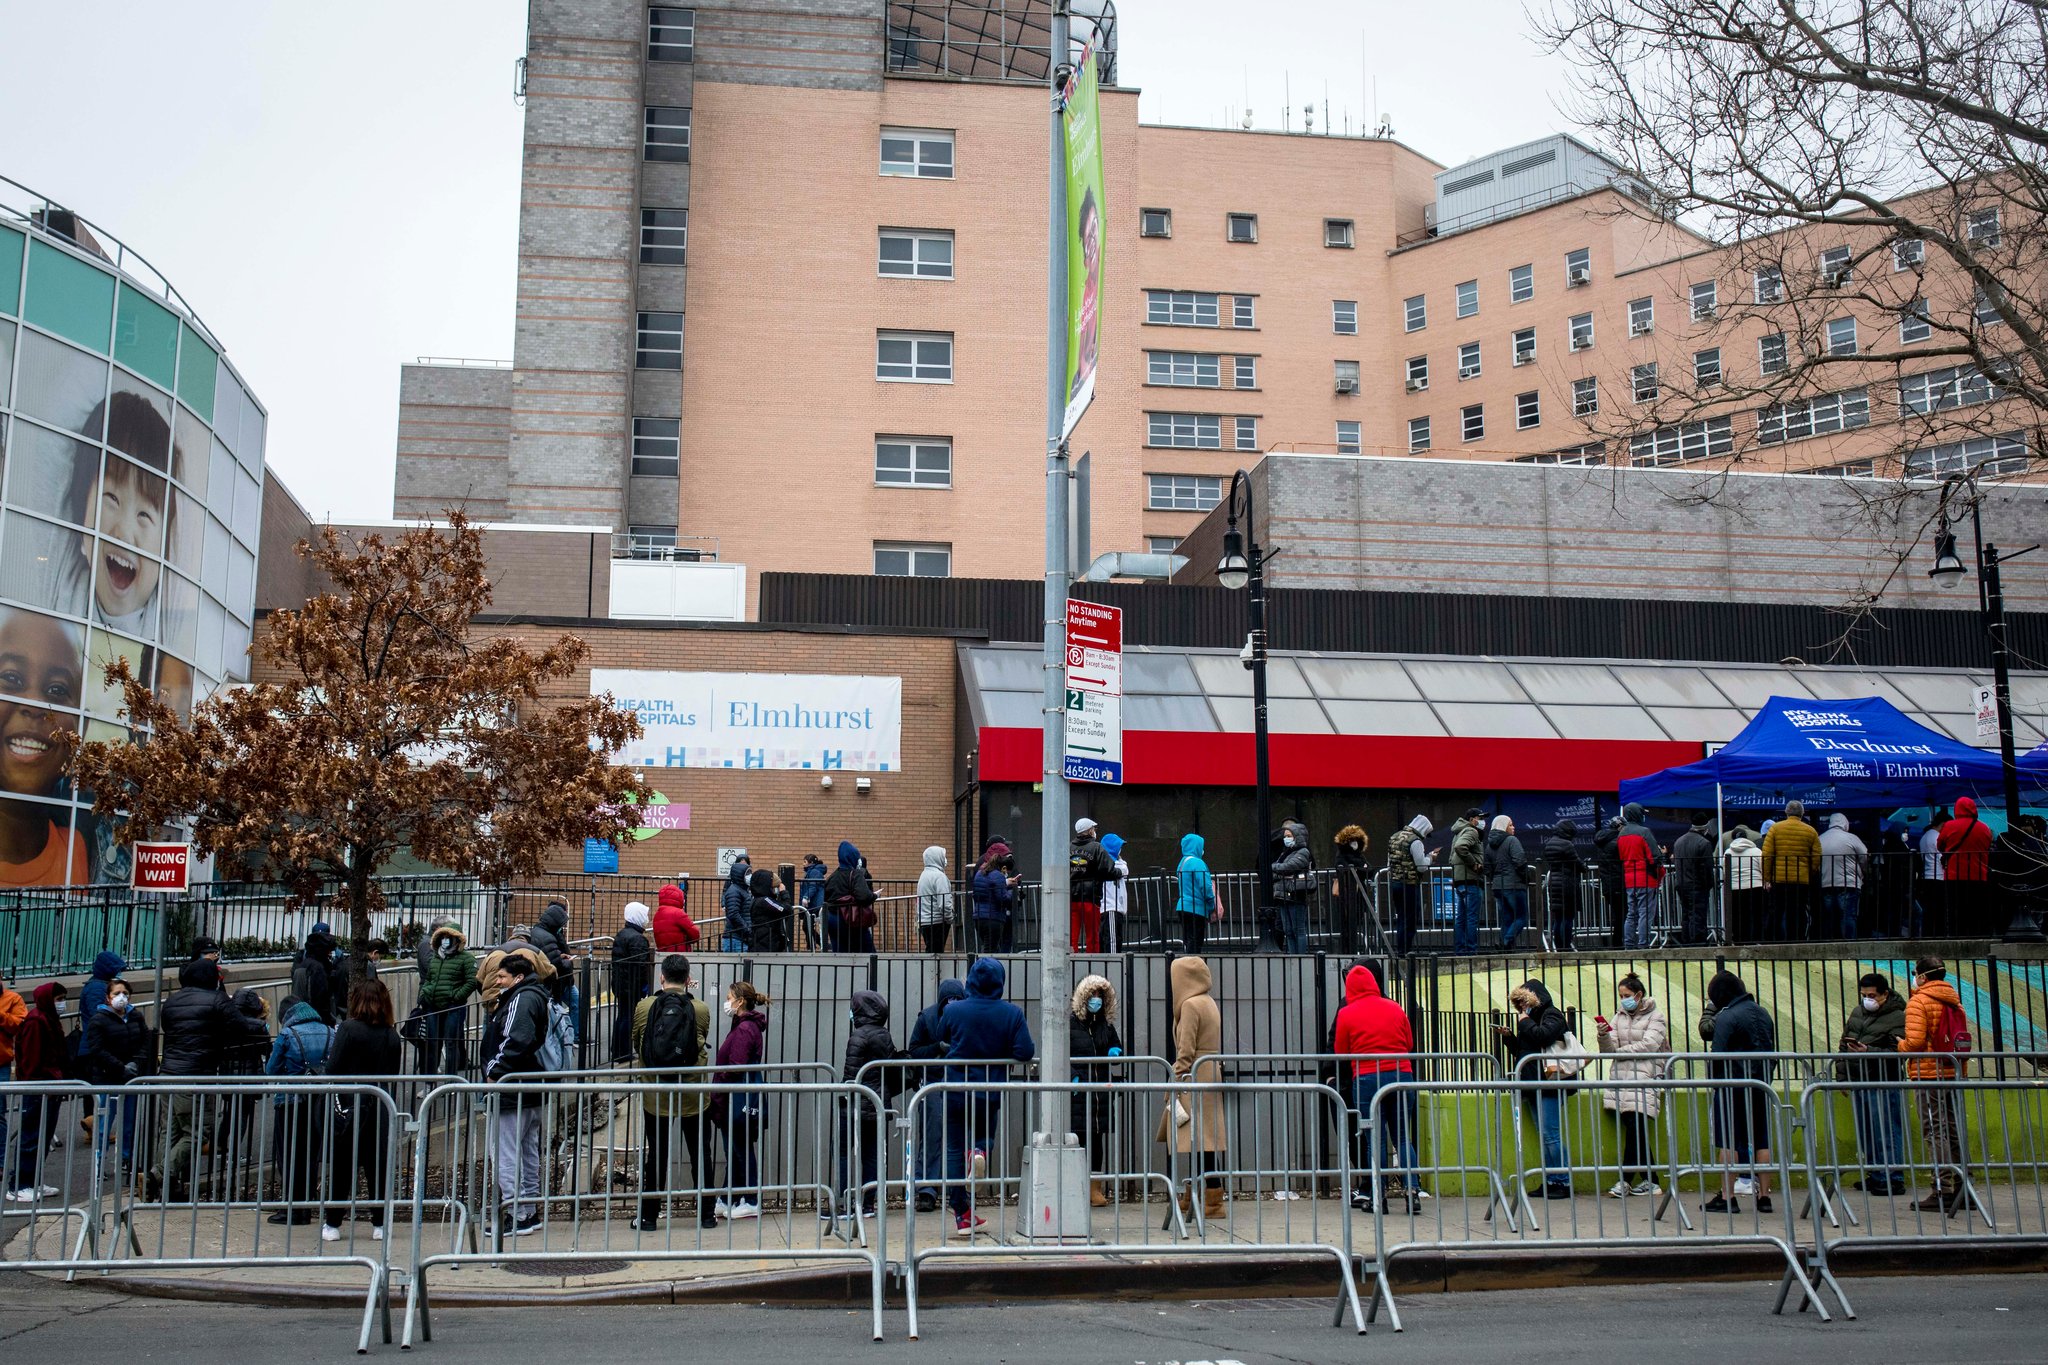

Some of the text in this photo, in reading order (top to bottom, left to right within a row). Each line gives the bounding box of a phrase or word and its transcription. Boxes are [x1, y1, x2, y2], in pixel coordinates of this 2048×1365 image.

[1070, 604, 1112, 620] NO STANDING
[1070, 615, 1097, 628] Anytime
[1086, 660, 1116, 671] Except Sunday
[1070, 691, 1079, 708] 2
[1981, 691, 1989, 702] P
[617, 699, 673, 711] HEALTH
[1085, 700, 1104, 708] metered
[728, 701, 873, 730] Elmhurst
[1085, 707, 1102, 715] parking
[1068, 717, 1088, 726] 8:30am
[1093, 720, 1104, 729] 7pm
[1793, 719, 1863, 728] HOSPITALS
[1068, 726, 1106, 738] Except Sunday
[1806, 737, 1938, 755] Elmhurst
[1066, 765, 1100, 779] 465220
[1829, 769, 1870, 777] HOSPITALS
[1885, 763, 1960, 778] Elmhurst
[138, 852, 186, 864] WRONG
[145, 870, 176, 881] WAY!
